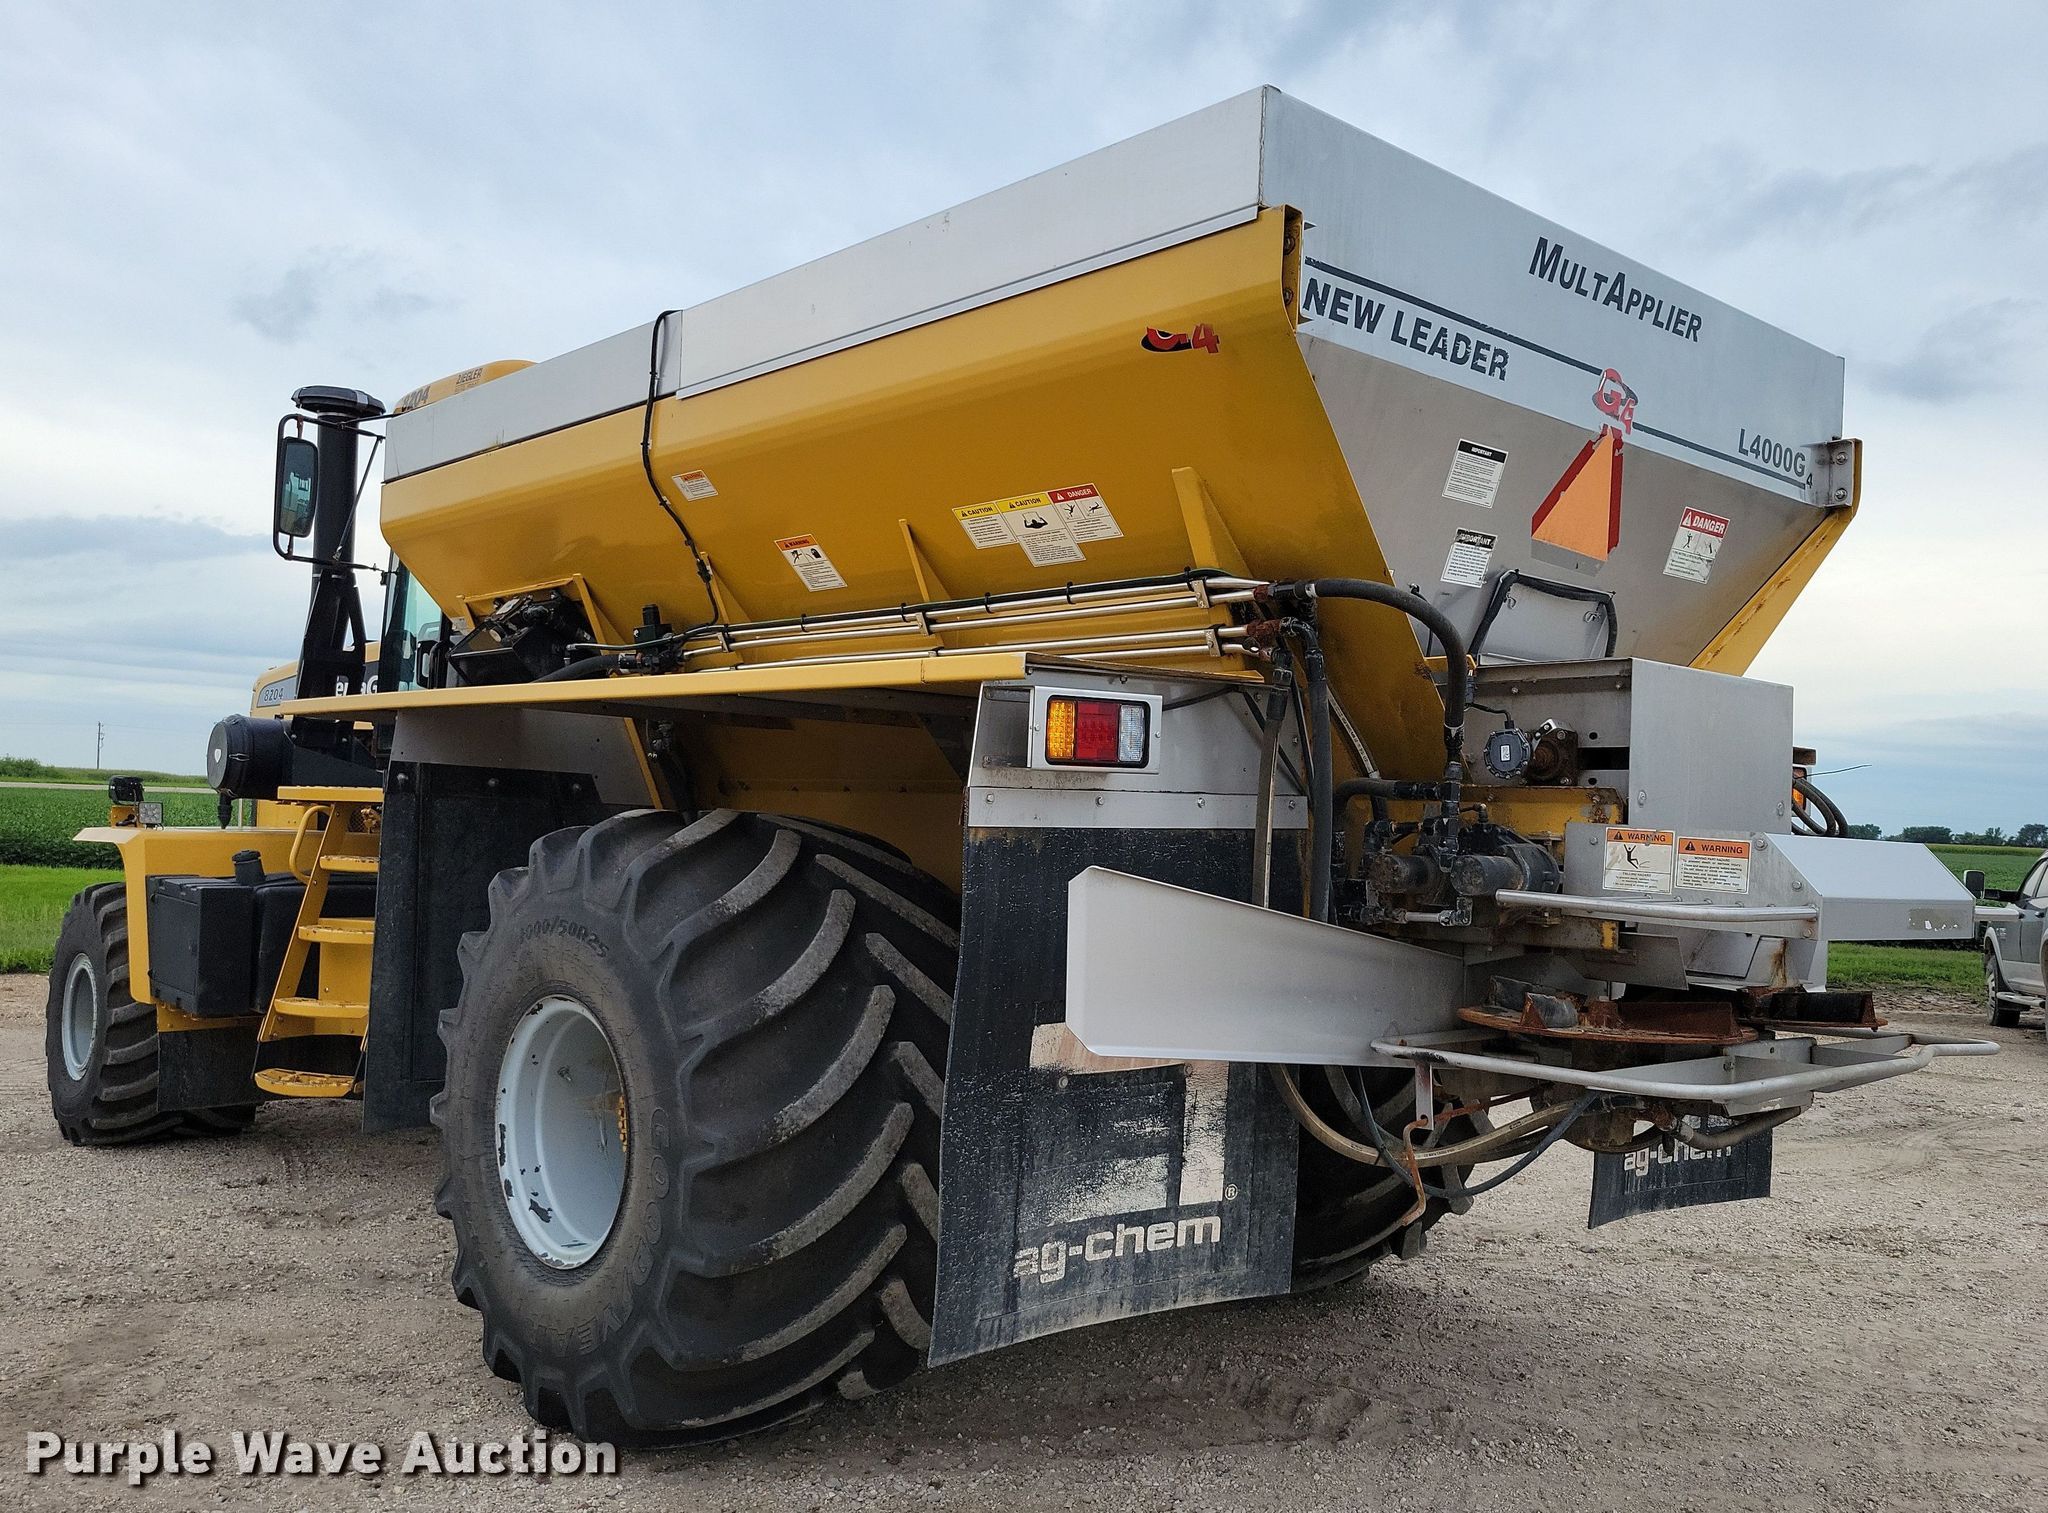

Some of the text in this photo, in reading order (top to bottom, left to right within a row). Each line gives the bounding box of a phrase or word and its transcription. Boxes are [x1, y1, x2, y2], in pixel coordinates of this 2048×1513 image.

[1302, 277, 1509, 382] NEW LEADER
[1067, 488, 1093, 498] DANGER
[1015, 497, 1042, 508] CAUTION
[967, 507, 994, 517] CAUTION
[1692, 515, 1726, 535] DANGER
[264, 687, 284, 702] 8204
[1627, 833, 1666, 843] WARNING
[1701, 843, 1743, 855] WARNING
[1013, 1215, 1222, 1284] ag-chem
